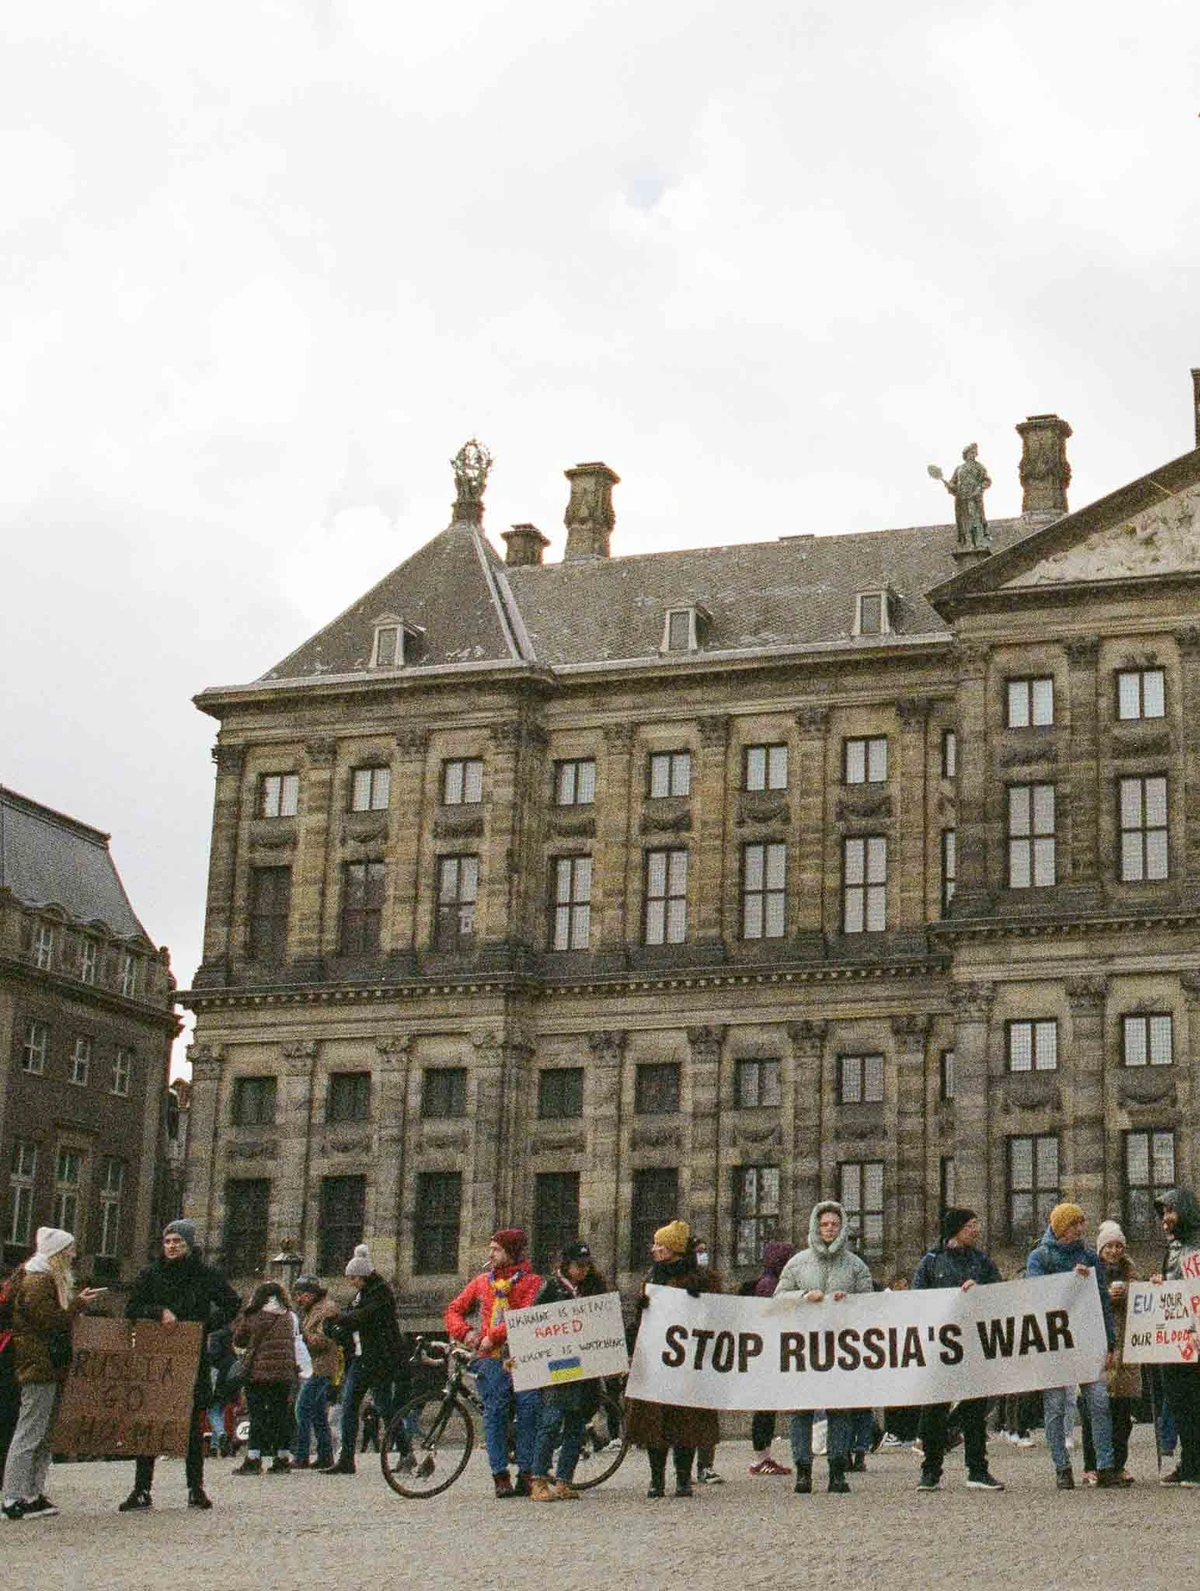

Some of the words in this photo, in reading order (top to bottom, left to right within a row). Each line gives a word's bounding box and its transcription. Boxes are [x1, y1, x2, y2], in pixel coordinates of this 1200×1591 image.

[1159, 1292, 1183, 1311] YOUR
[558, 1307, 568, 1318] IS
[534, 1319, 584, 1339] RAPED
[1131, 1331, 1152, 1347] OUR
[1155, 1329, 1192, 1345] BLOOD
[561, 1344, 573, 1355] IS
[661, 1324, 764, 1373] STOP
[779, 1323, 964, 1373] RUSSIA'S
[976, 1309, 1075, 1360] WAR
[101, 1383, 145, 1413] GO
[72, 1413, 177, 1452] HOME
